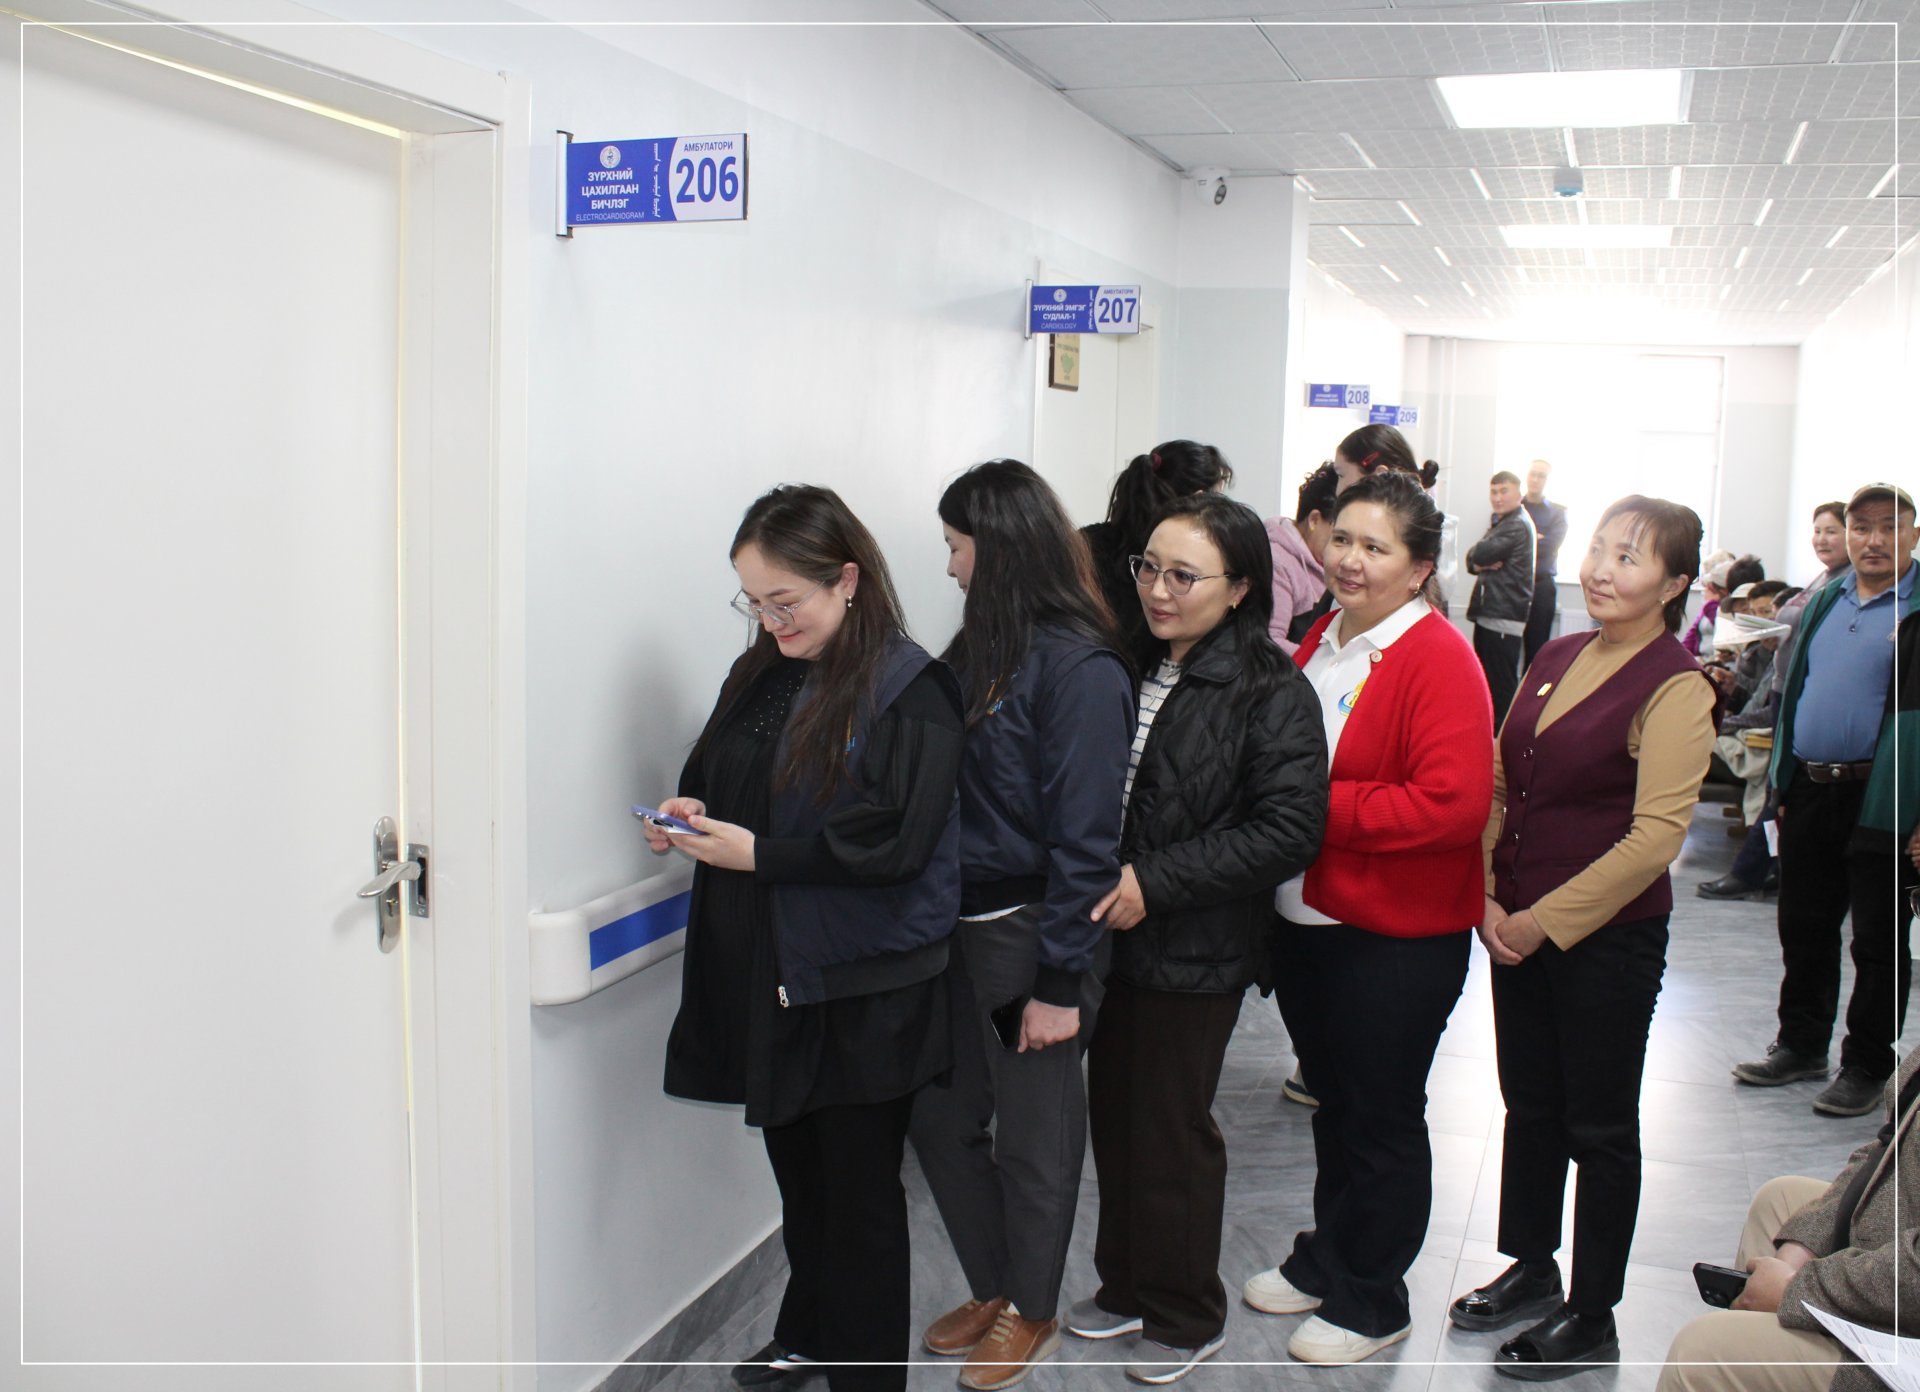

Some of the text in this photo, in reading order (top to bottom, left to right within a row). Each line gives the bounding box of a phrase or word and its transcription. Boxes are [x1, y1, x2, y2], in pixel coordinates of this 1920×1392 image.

[683, 141, 733, 152] АМБУЛАТОРИ
[588, 167, 633, 182] ЗҮРХНИЙ
[675, 156, 739, 203] 206
[581, 184, 639, 197] ЦАХИЛГААН
[591, 199, 629, 210] БИЧЛЭГ
[576, 211, 645, 222] ELECTROCARDIOGRAM
[1098, 297, 1137, 323] 207
[1042, 313, 1076, 321] СУДЛАЛ-1
[1347, 390, 1369, 405] 208
[1399, 411, 1417, 423] 209
